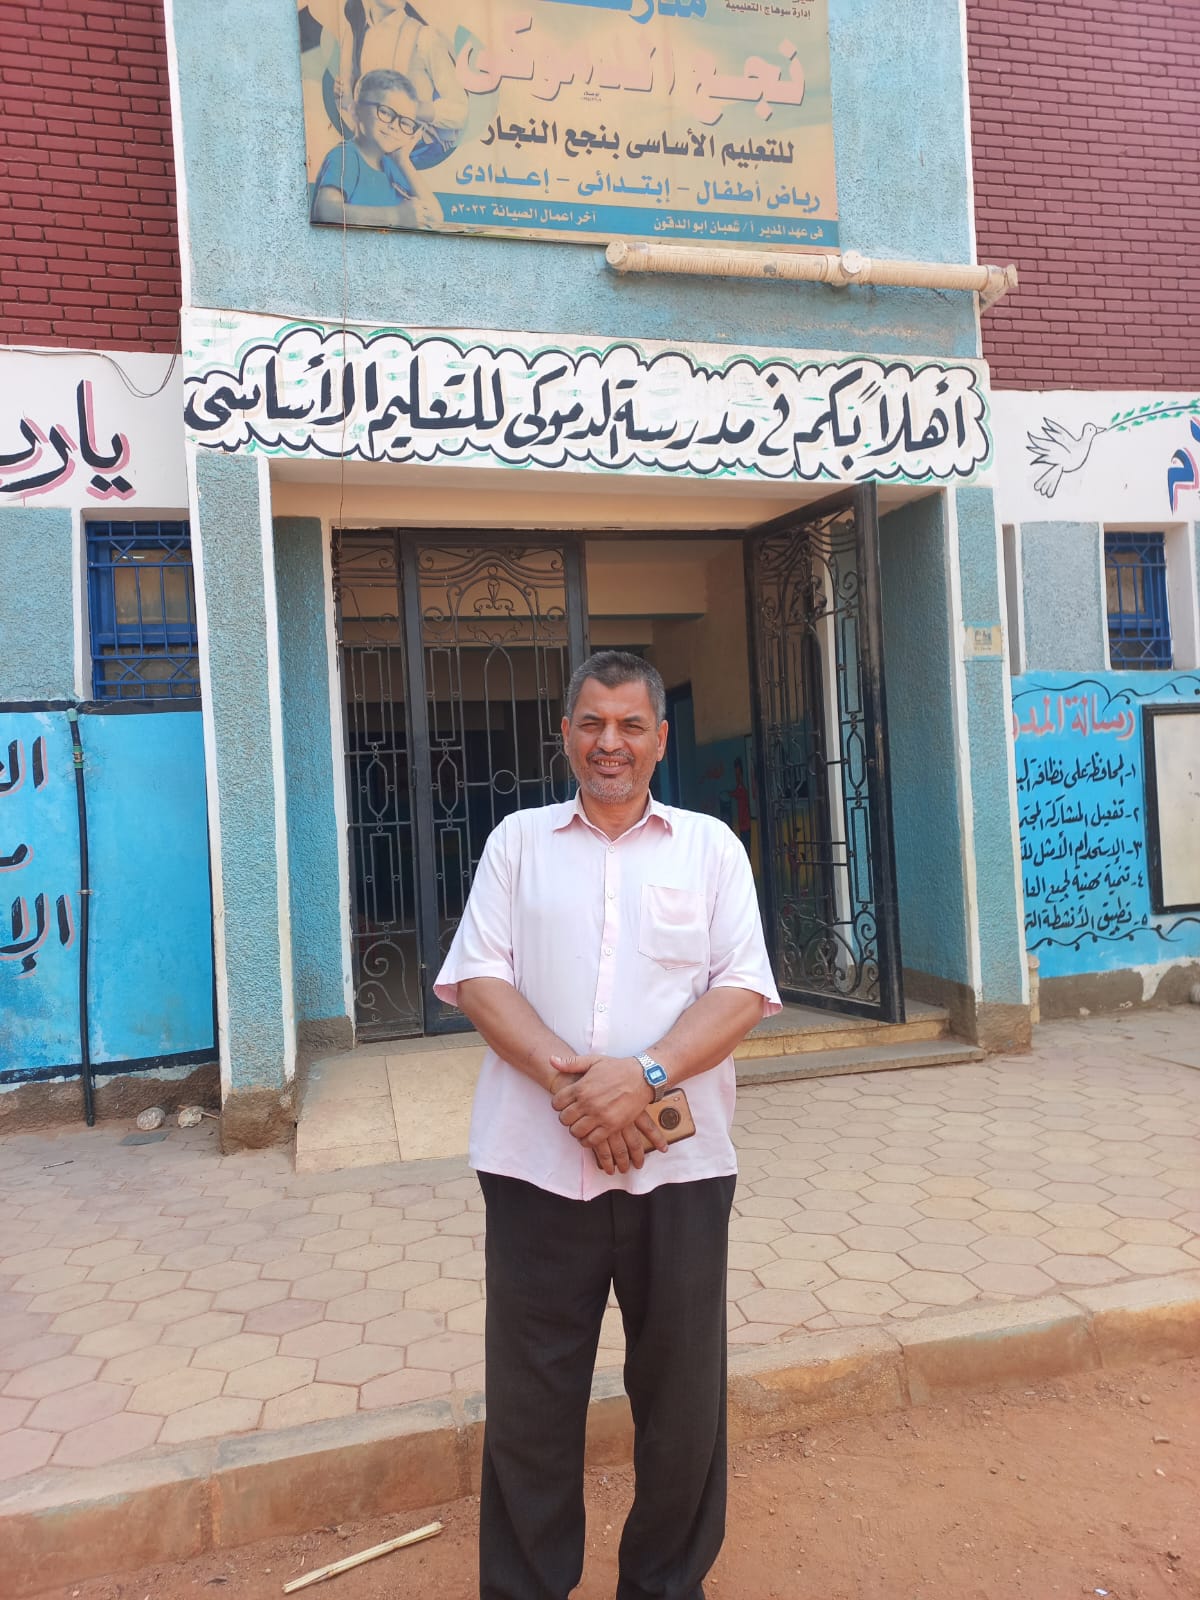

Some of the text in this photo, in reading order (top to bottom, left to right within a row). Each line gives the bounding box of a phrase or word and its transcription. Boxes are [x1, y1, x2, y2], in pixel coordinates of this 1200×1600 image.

[480, 115, 795, 170] للتعليم الأساسى بنجع النجار
[456, 163, 550, 194] إعدادى
[697, 179, 761, 206] أطفال
[492, 203, 538, 221] الصيانة
[767, 186, 821, 214] رياض
[709, 219, 741, 236] شعبان
[759, 218, 787, 239] المدير
[788, 222, 808, 239] عهد
[184, 352, 379, 431] الأساسى
[367, 355, 504, 459] للتعليم
[612, 379, 756, 450] مدرسة
[1065, 688, 1136, 740] رسالة
[1032, 757, 1064, 791] نظافة
[1063, 757, 1090, 789] على
[1091, 799, 1125, 827] تفعيل
[1033, 831, 1073, 867] الأمثل
[1105, 864, 1131, 895] تنمية
[1042, 904, 1095, 931] الأنشطة
[1097, 896, 1133, 936] تطبيق
